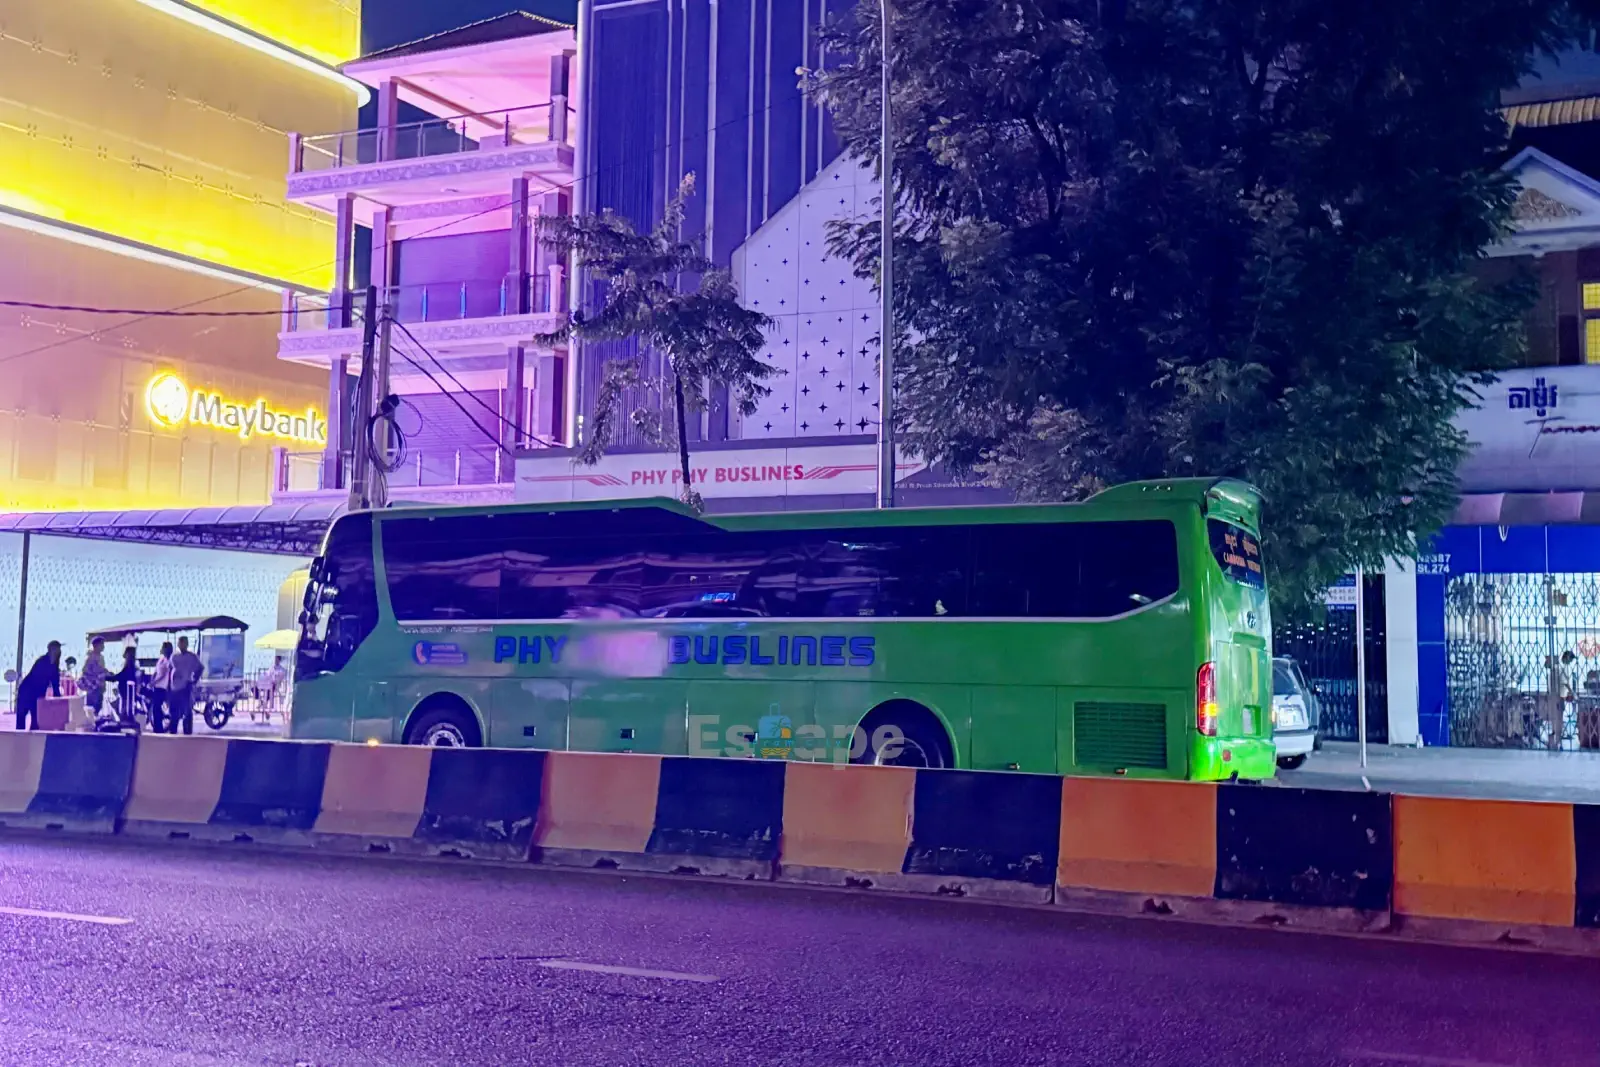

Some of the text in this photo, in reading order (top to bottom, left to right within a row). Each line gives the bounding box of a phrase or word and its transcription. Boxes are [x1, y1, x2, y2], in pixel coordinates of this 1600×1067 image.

[191, 392, 327, 443] Maybank
[631, 464, 804, 486] PHY PHY BUSLINES
[494, 635, 567, 664] PHY
[668, 635, 876, 666] BUSLINES
